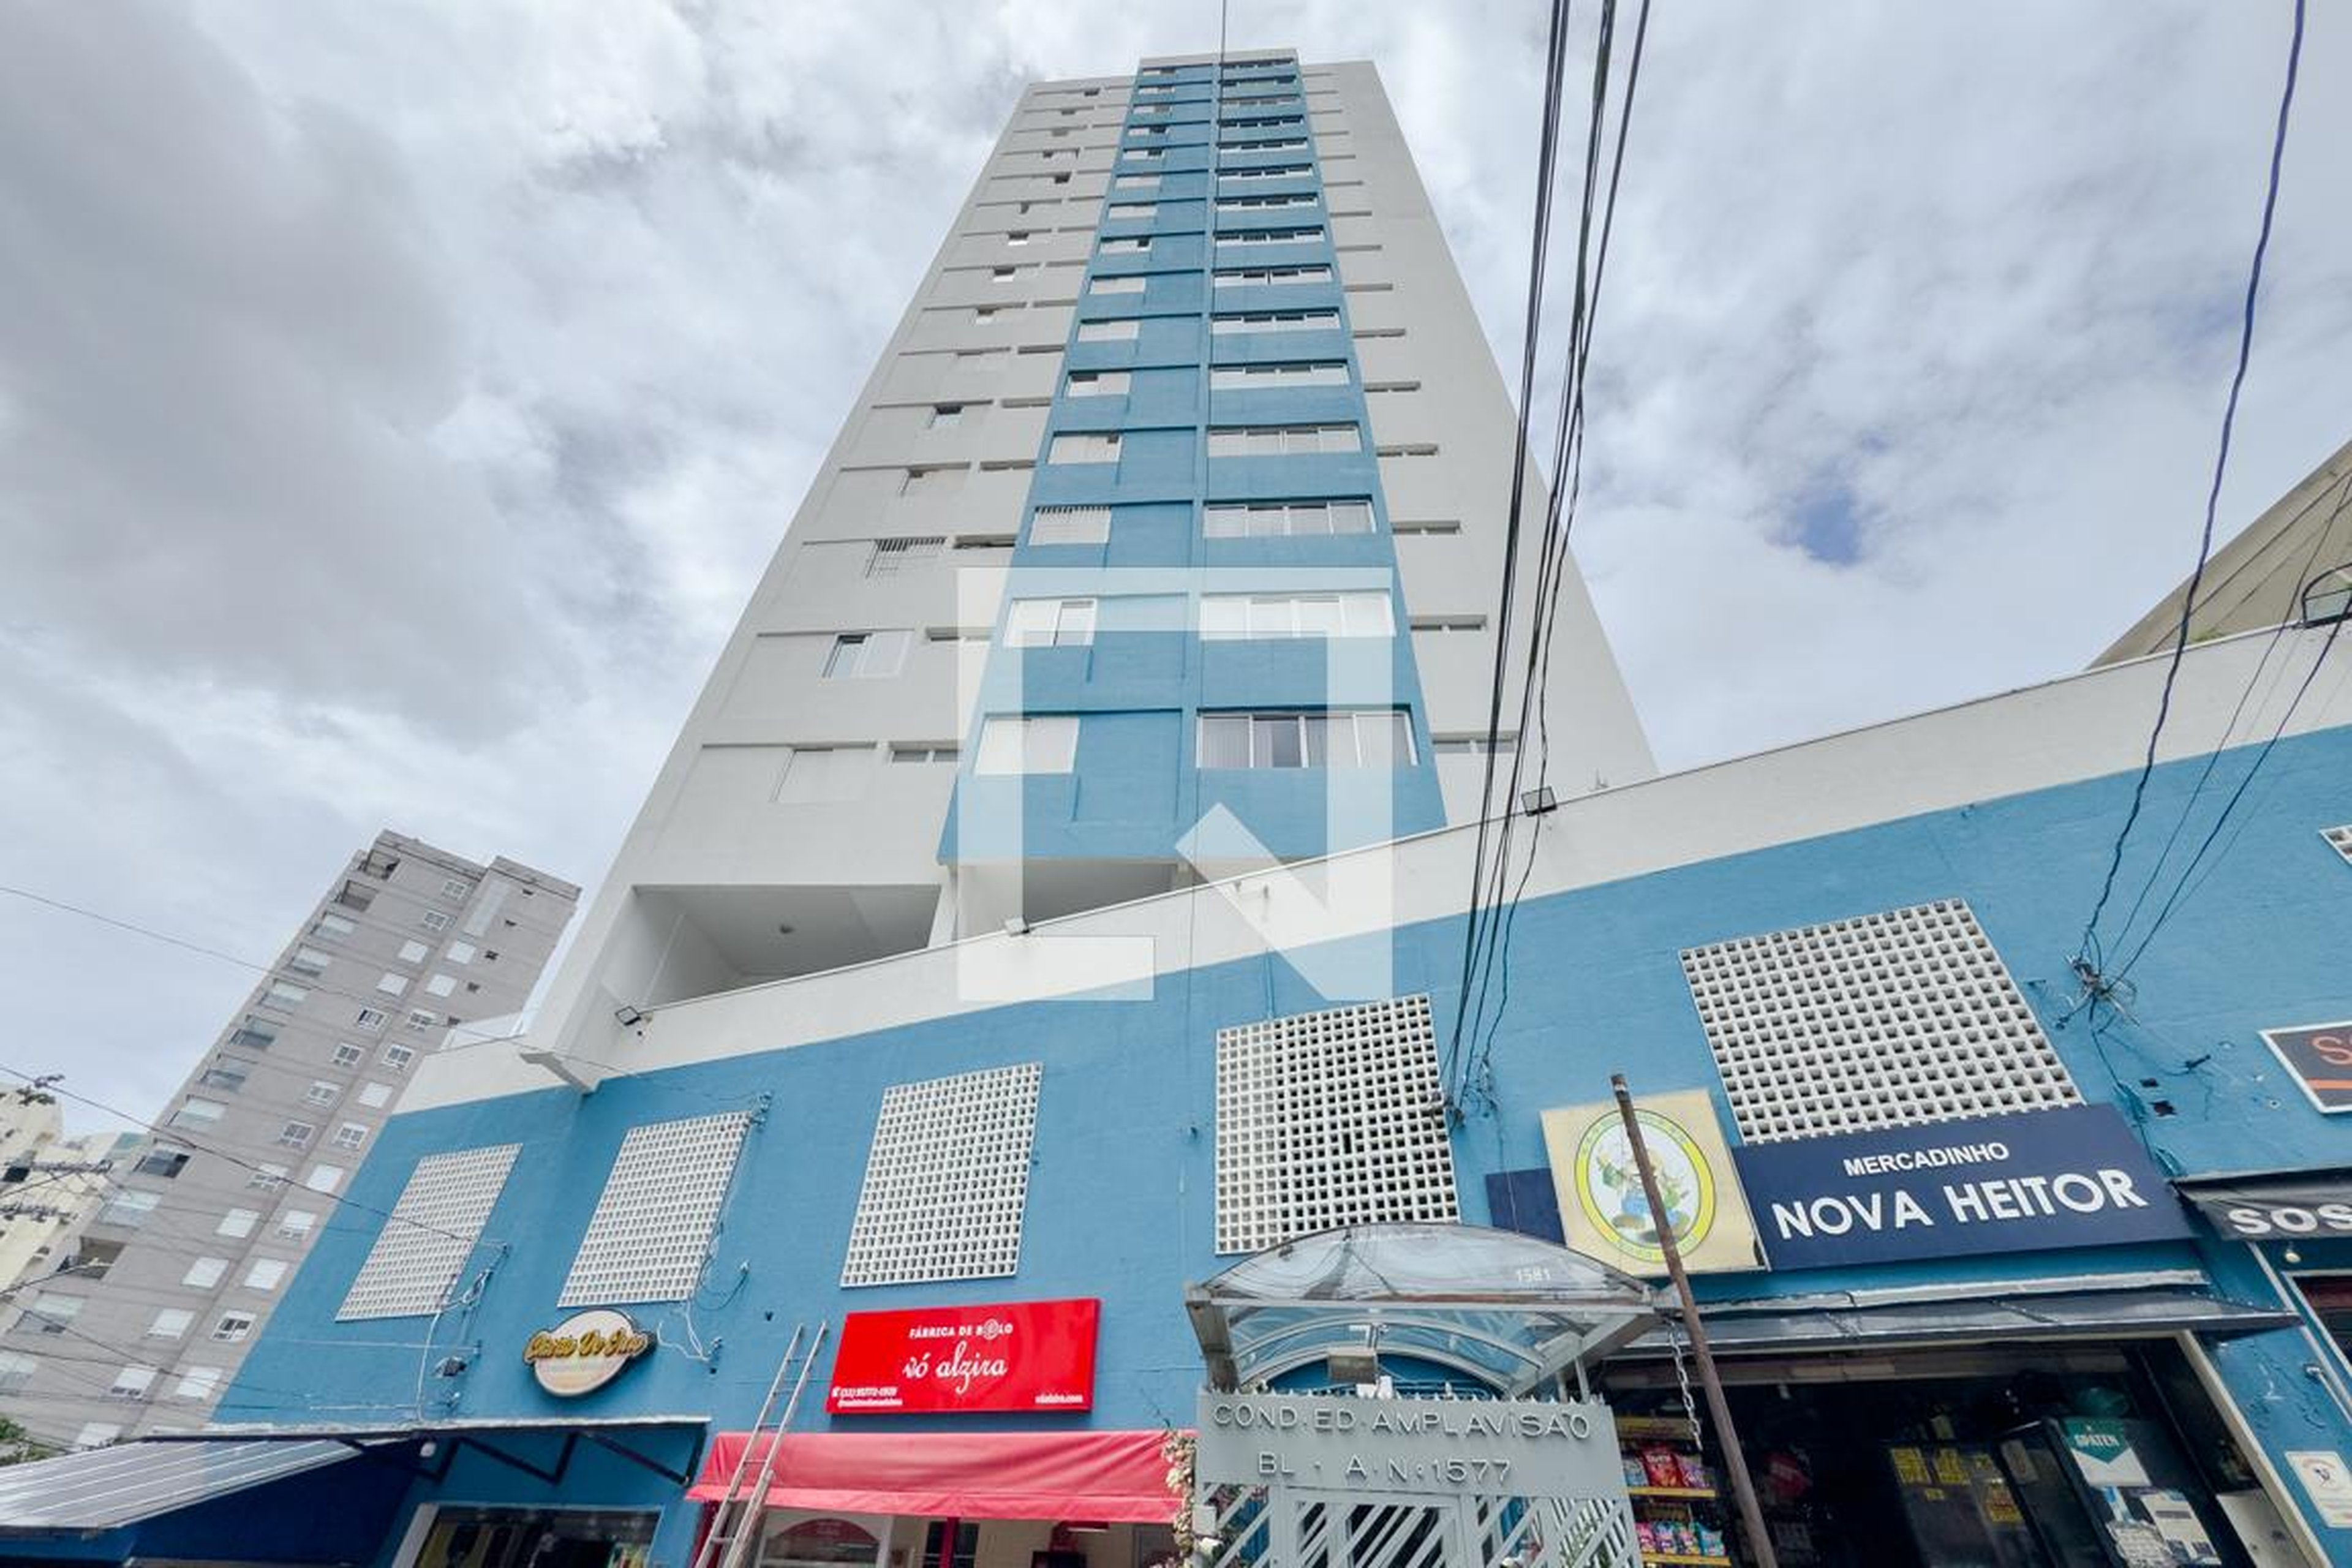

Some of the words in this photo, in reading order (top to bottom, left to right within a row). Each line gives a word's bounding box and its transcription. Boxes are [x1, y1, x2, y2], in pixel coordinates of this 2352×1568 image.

[1843, 1142, 2009, 1177] MERCADINHO
[1772, 1190, 1934, 1239] NOVA
[1943, 1169, 2149, 1223] HEITOR
[959, 1325, 972, 1336] DE
[935, 1340, 1008, 1395] alzira
